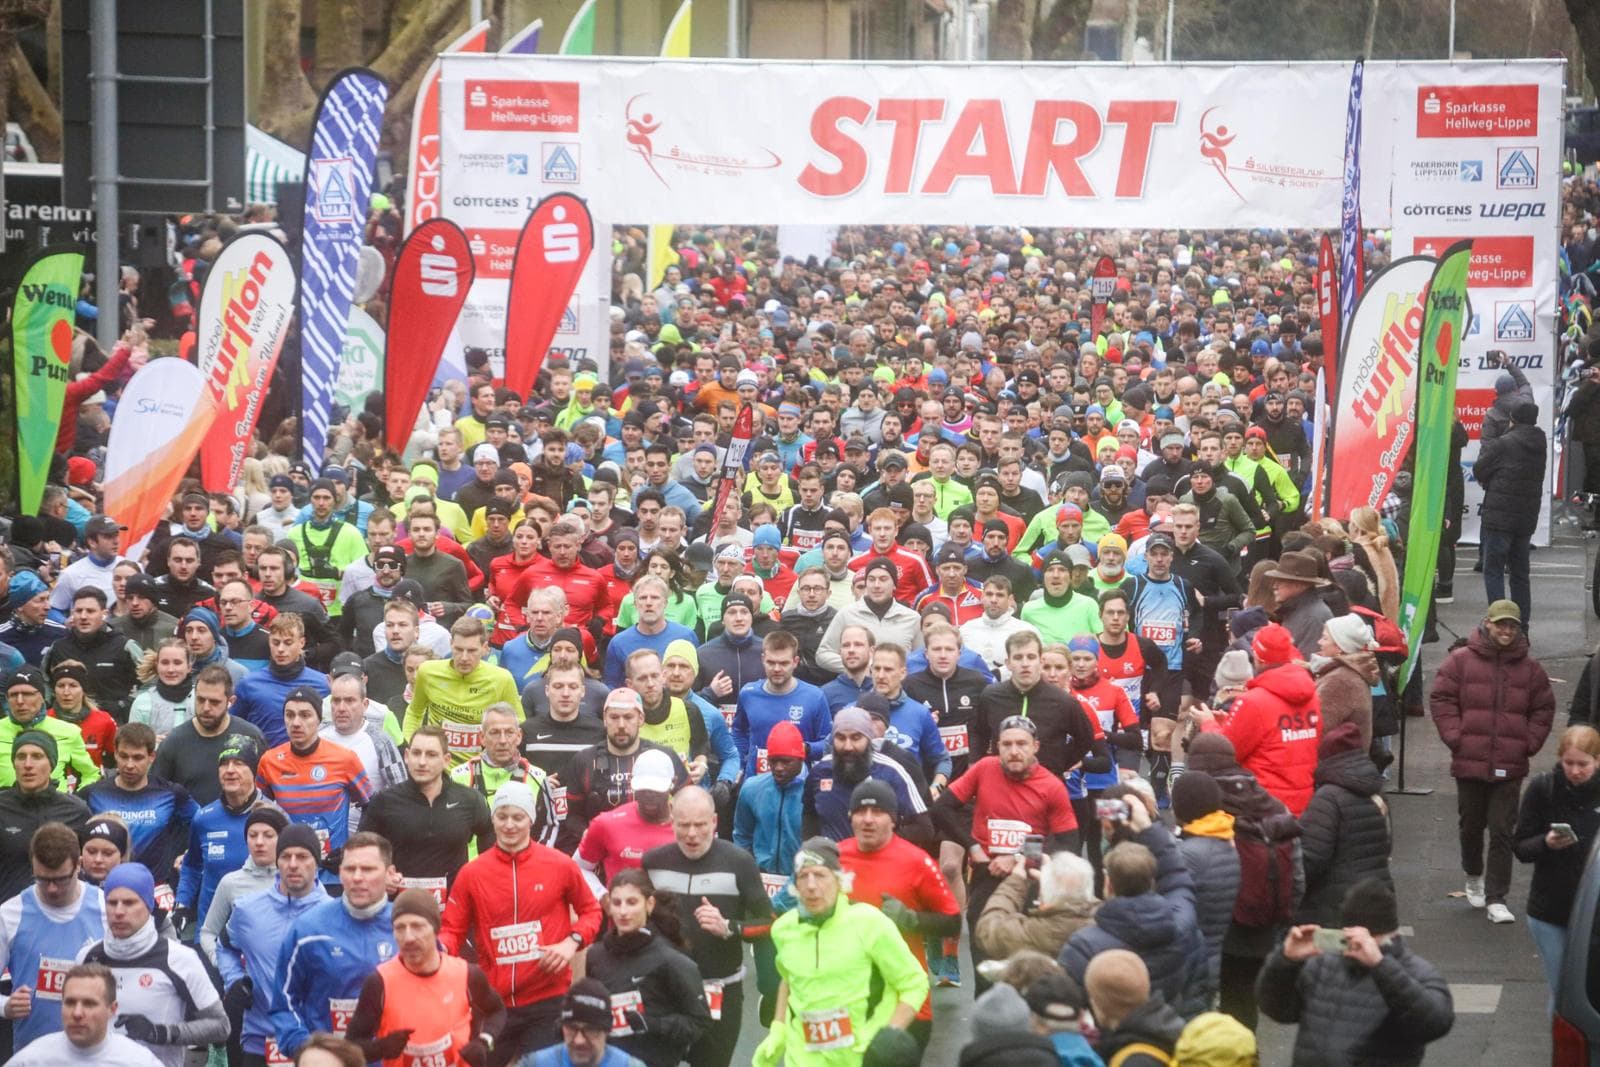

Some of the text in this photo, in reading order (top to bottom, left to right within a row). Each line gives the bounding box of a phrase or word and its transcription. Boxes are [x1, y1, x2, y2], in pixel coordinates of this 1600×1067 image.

[491, 96, 549, 109] Sparkasse
[1446, 101, 1506, 115] Sparkasse
[491, 112, 574, 126] Hellweg-Lippe
[1445, 117, 1532, 132] Hellweg-Lippe
[796, 95, 1177, 198] START
[459, 153, 506, 161] PADERBORN
[462, 161, 505, 169] LIPPSTADT
[1410, 160, 1460, 169] PADERBORN
[547, 172, 574, 181] ALDI
[1414, 169, 1458, 177] LIPPSTADT
[1503, 177, 1532, 187] ALDI
[453, 195, 519, 208] GÖTTGENS
[1403, 202, 1472, 216] GÖTTGENS
[1480, 202, 1546, 221] wepa
[1502, 330, 1529, 340] ALDI
[1352, 337, 1383, 395] möbel
[1380, 422, 1409, 471] Freude
[1144, 626, 1174, 639] 1736
[1278, 710, 1318, 730] OSC
[445, 731, 478, 747] 3511
[1281, 728, 1317, 743] Hamm
[990, 831, 1025, 846] 5705
[496, 934, 539, 955] 4082
[808, 1021, 841, 1043] 214
